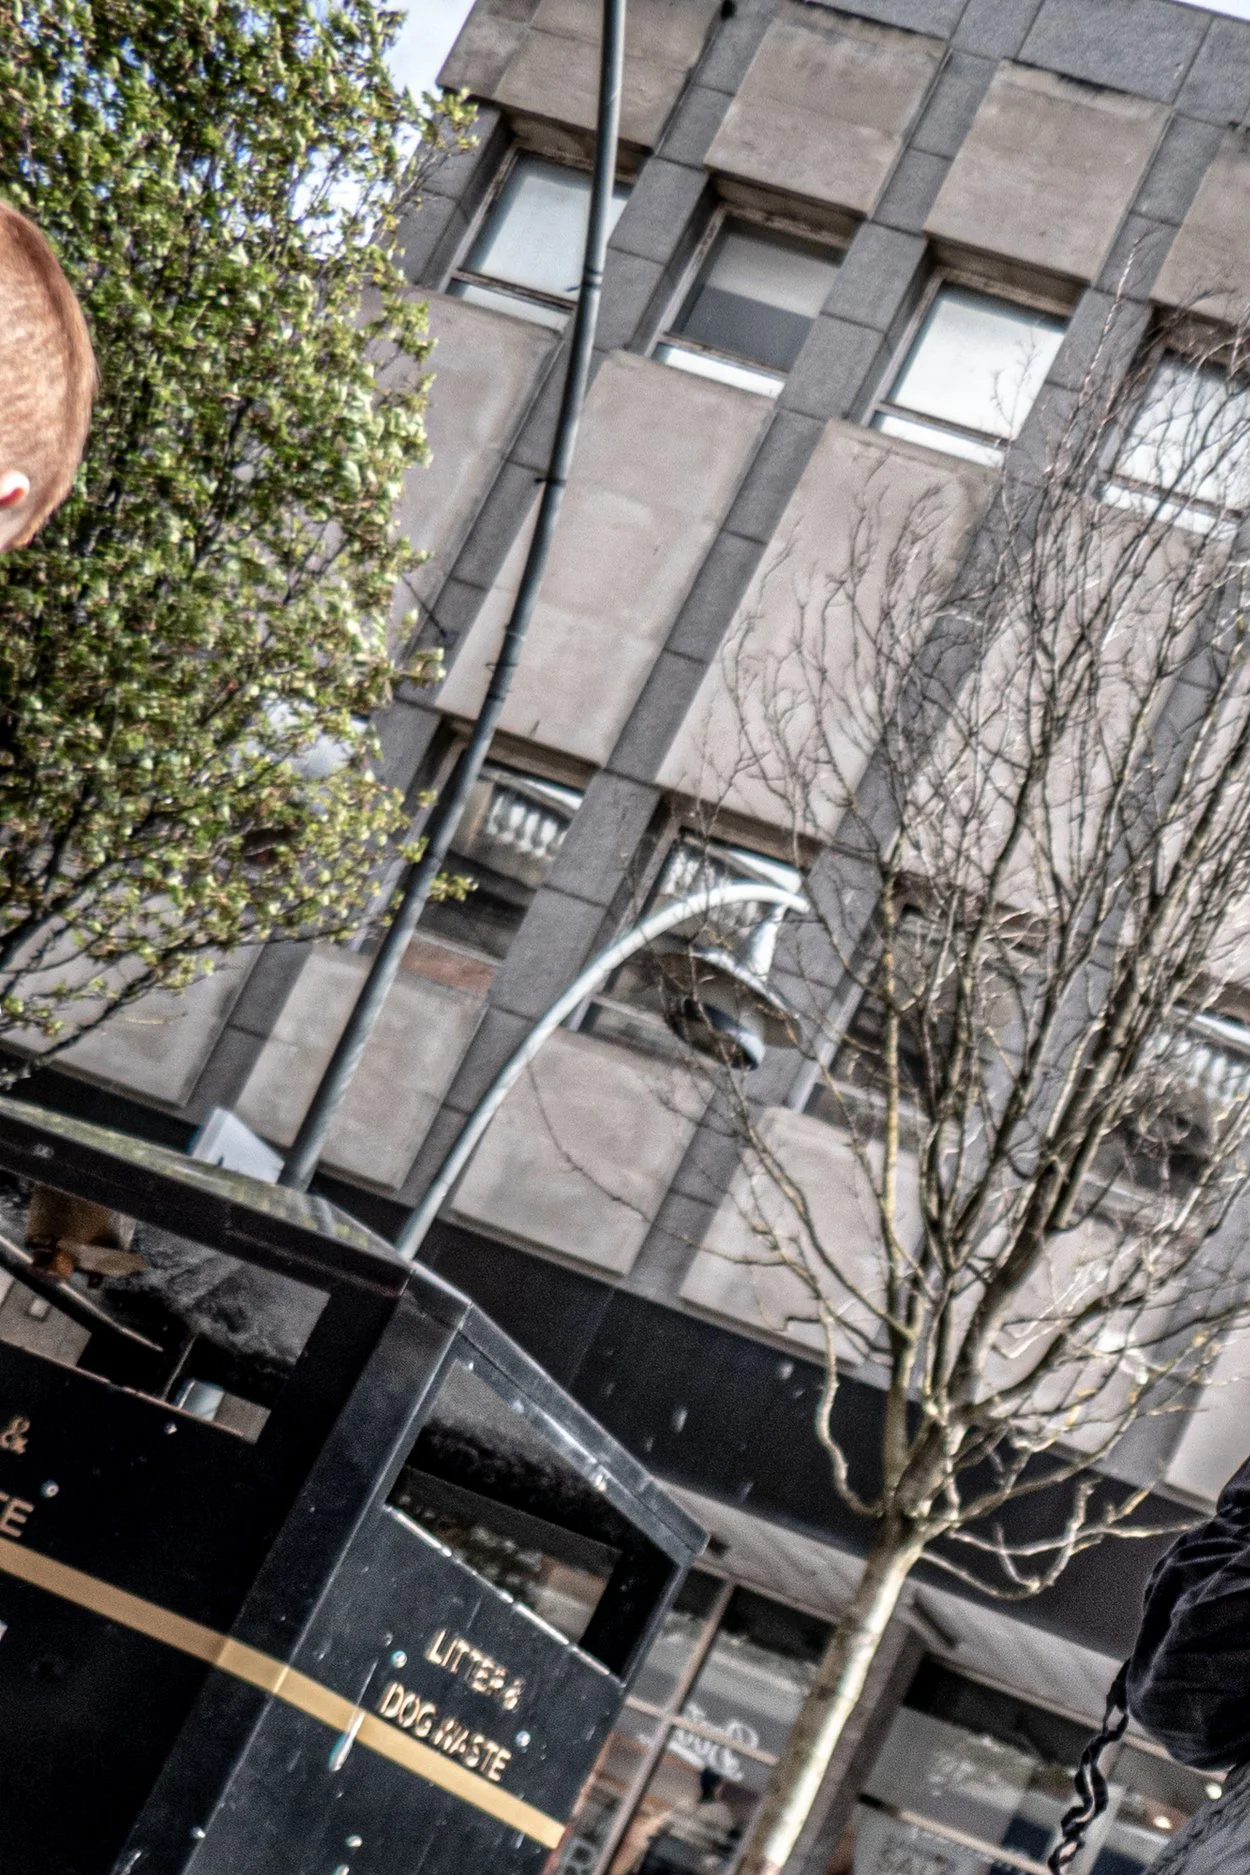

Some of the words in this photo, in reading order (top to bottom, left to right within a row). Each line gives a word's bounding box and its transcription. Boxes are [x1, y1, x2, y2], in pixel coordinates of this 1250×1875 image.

[0, 1491, 35, 1538] E
[424, 1628, 508, 1695] LITTER
[378, 1681, 438, 1738] DOG
[431, 1717, 513, 1782] WASTE
